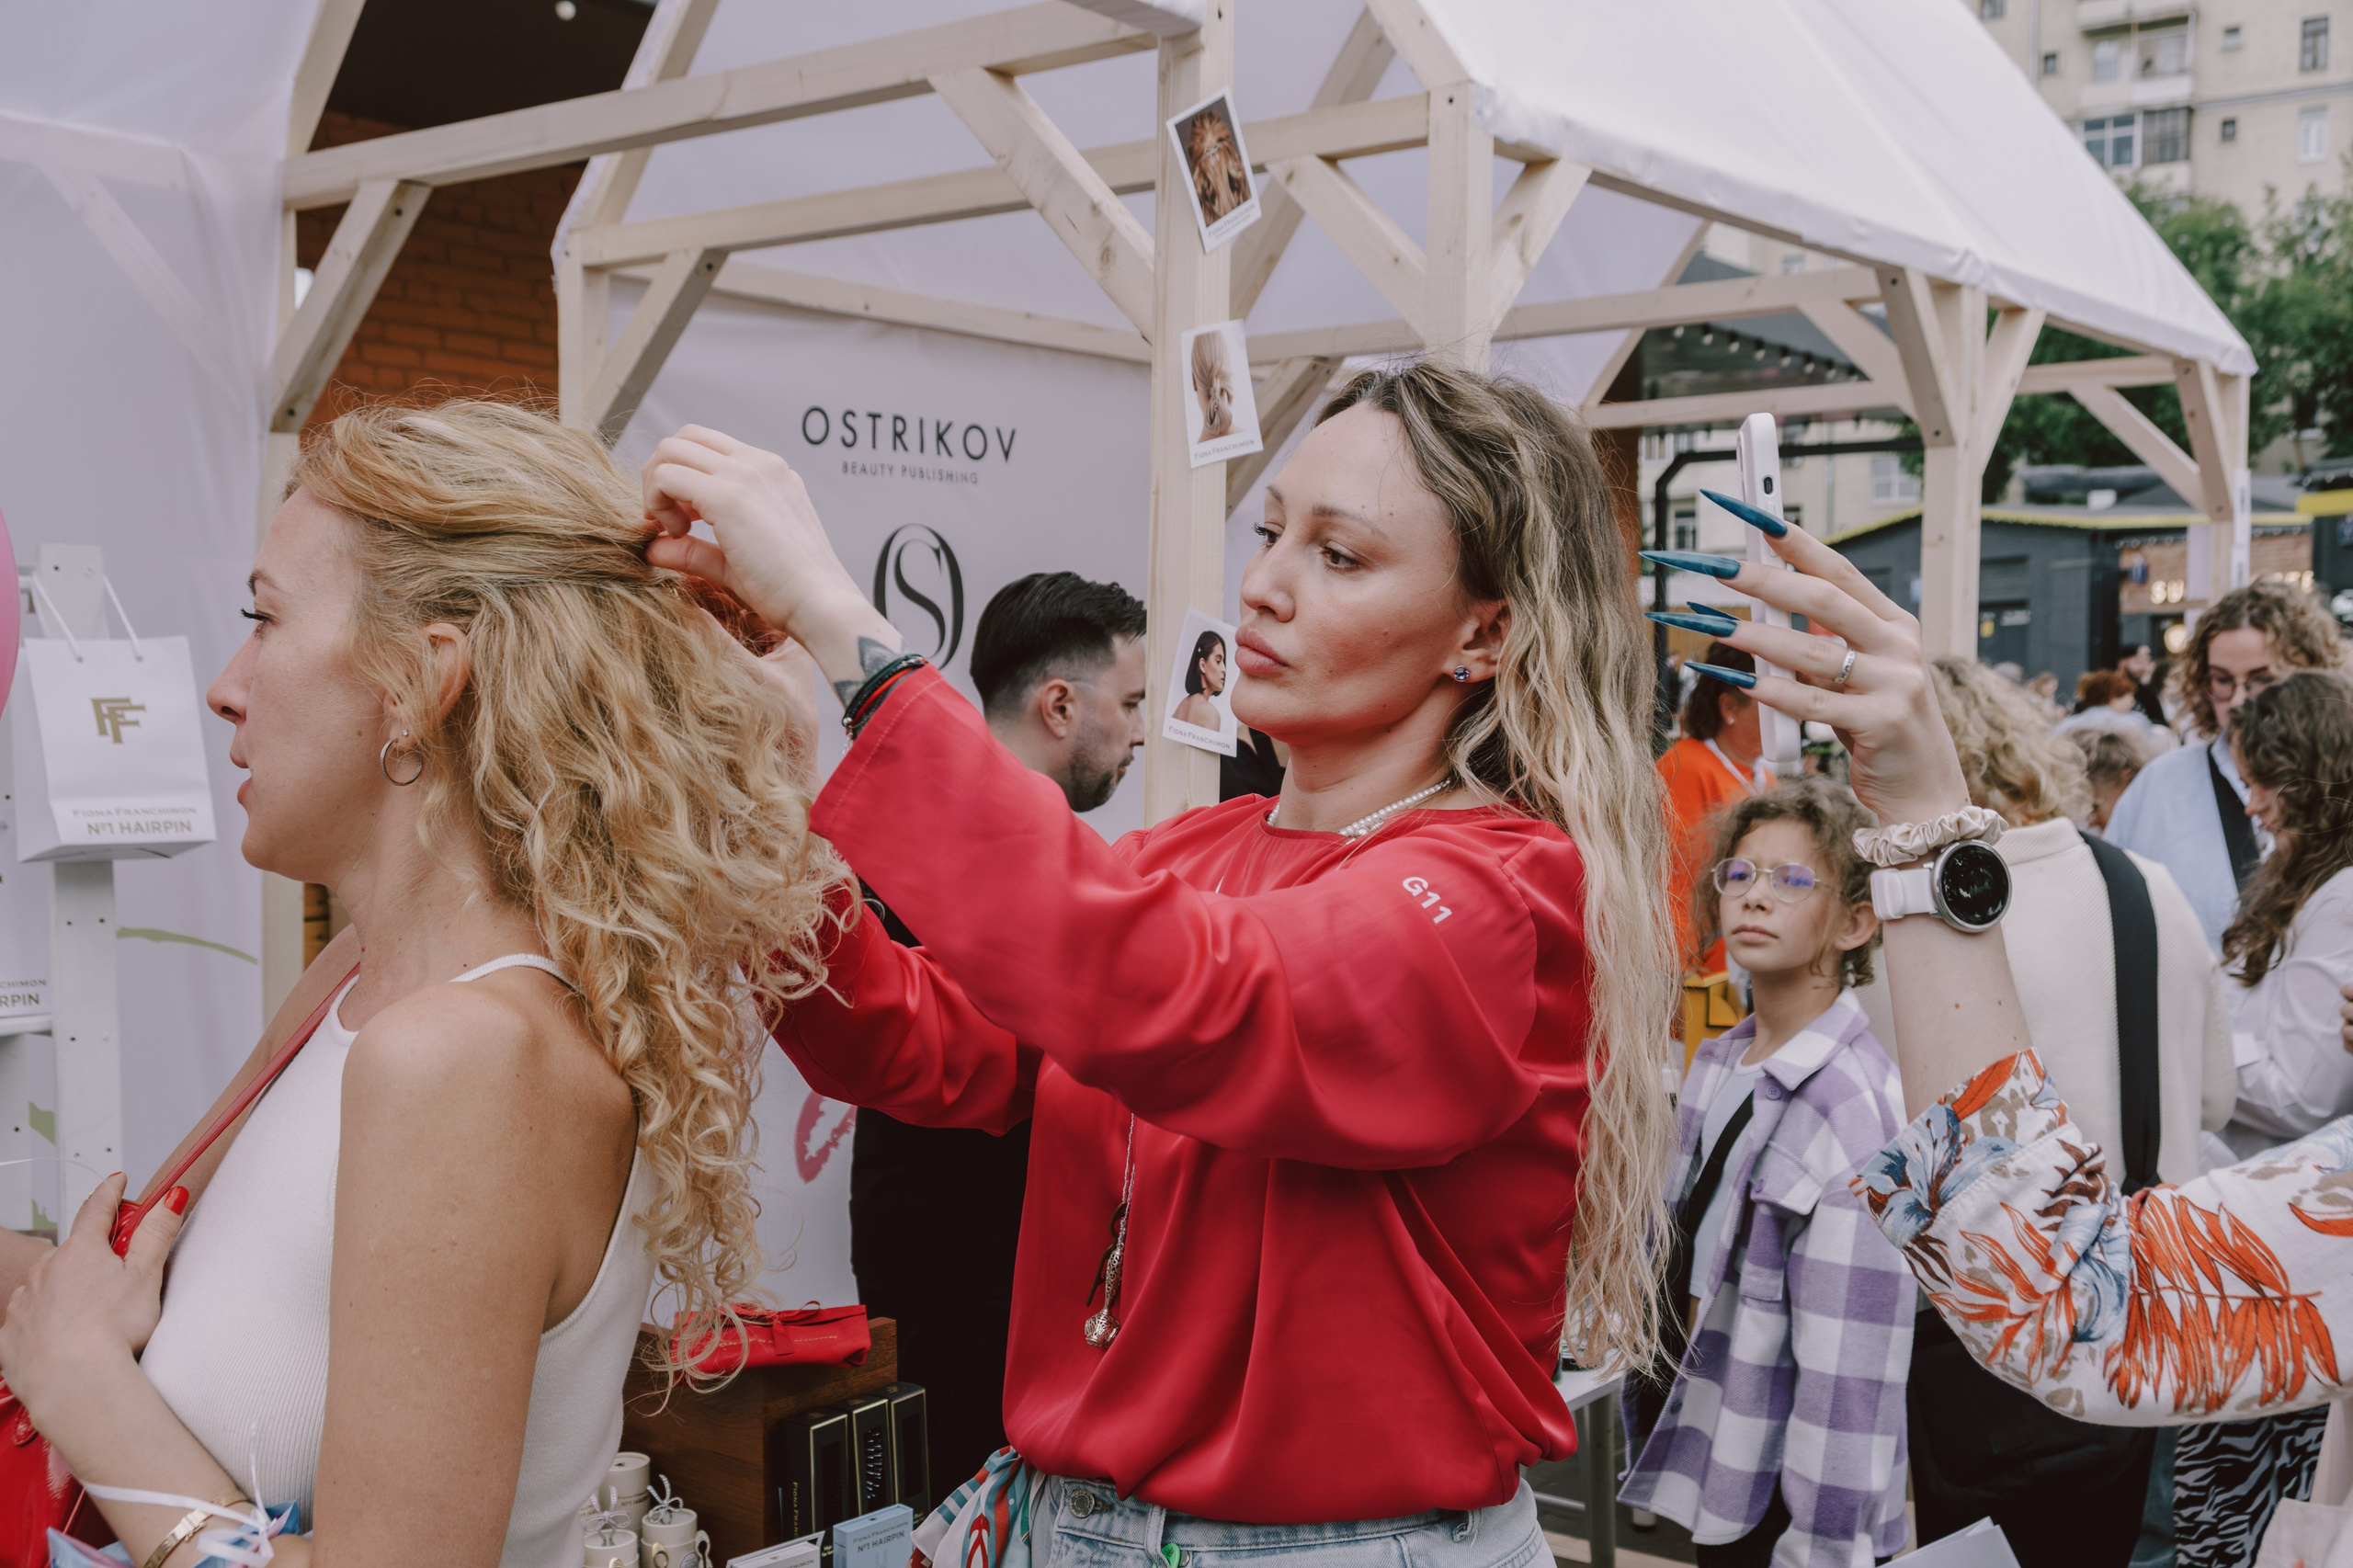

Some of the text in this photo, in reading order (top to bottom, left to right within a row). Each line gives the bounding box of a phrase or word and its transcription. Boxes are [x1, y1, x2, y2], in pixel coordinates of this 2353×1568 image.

[802, 406, 1016, 461] OSTRIKOV
[1195, 439, 1255, 460] FIONA FRANCHIMON
[842, 461, 978, 483] BEAUTY PUBLISHING
[1168, 725, 1231, 749] FIONA FRANCHIMON
[114, 807, 197, 815] FRANCHIMON
[119, 820, 192, 834] HAIRPIN
[1403, 876, 1453, 925] G11
[853, 1534, 870, 1543] FIONA
[872, 1530, 904, 1548] HAIRPIN
